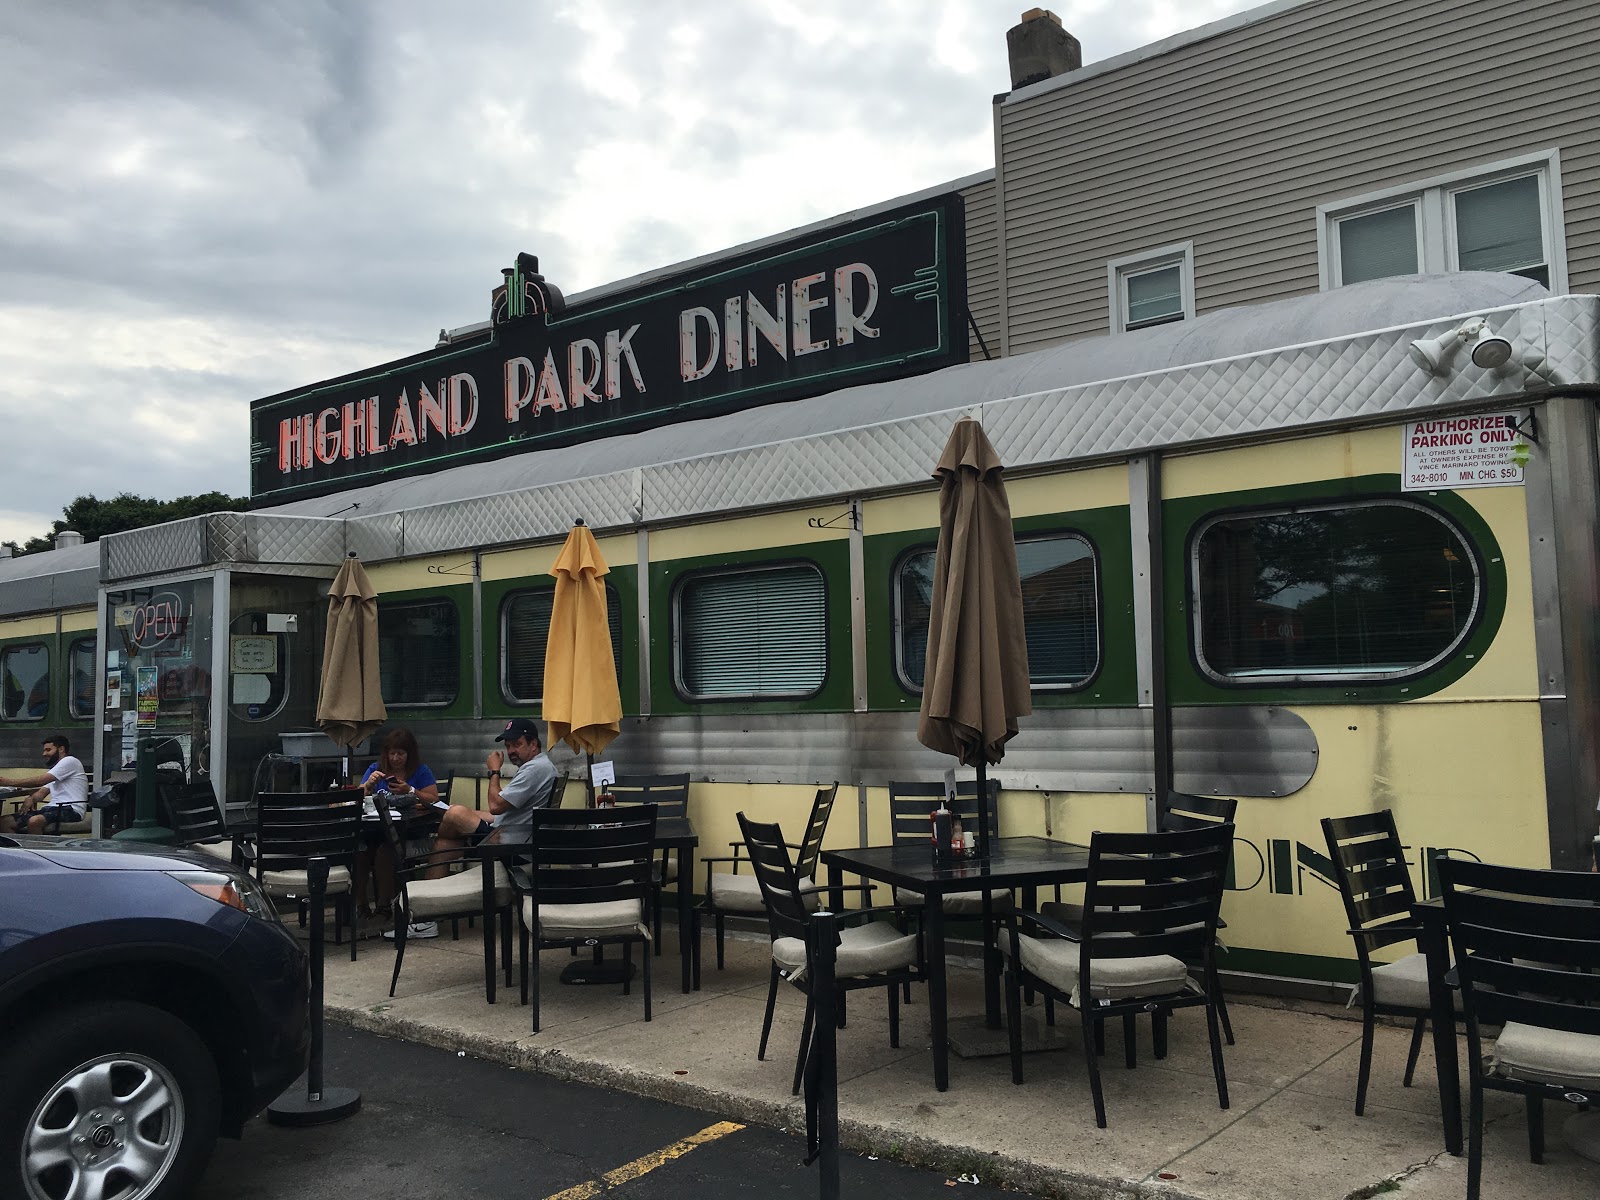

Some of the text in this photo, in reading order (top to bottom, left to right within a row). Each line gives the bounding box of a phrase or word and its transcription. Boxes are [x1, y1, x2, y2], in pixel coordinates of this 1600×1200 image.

[278, 262, 880, 474] HIGHLAND PARK DINER
[1414, 416, 1514, 435] AUTHORIZE
[1412, 430, 1517, 448] PARKING ONLY
[1411, 468, 1517, 483] 342-8010 MIN. CHG. $50
[133, 600, 178, 640] OPEN
